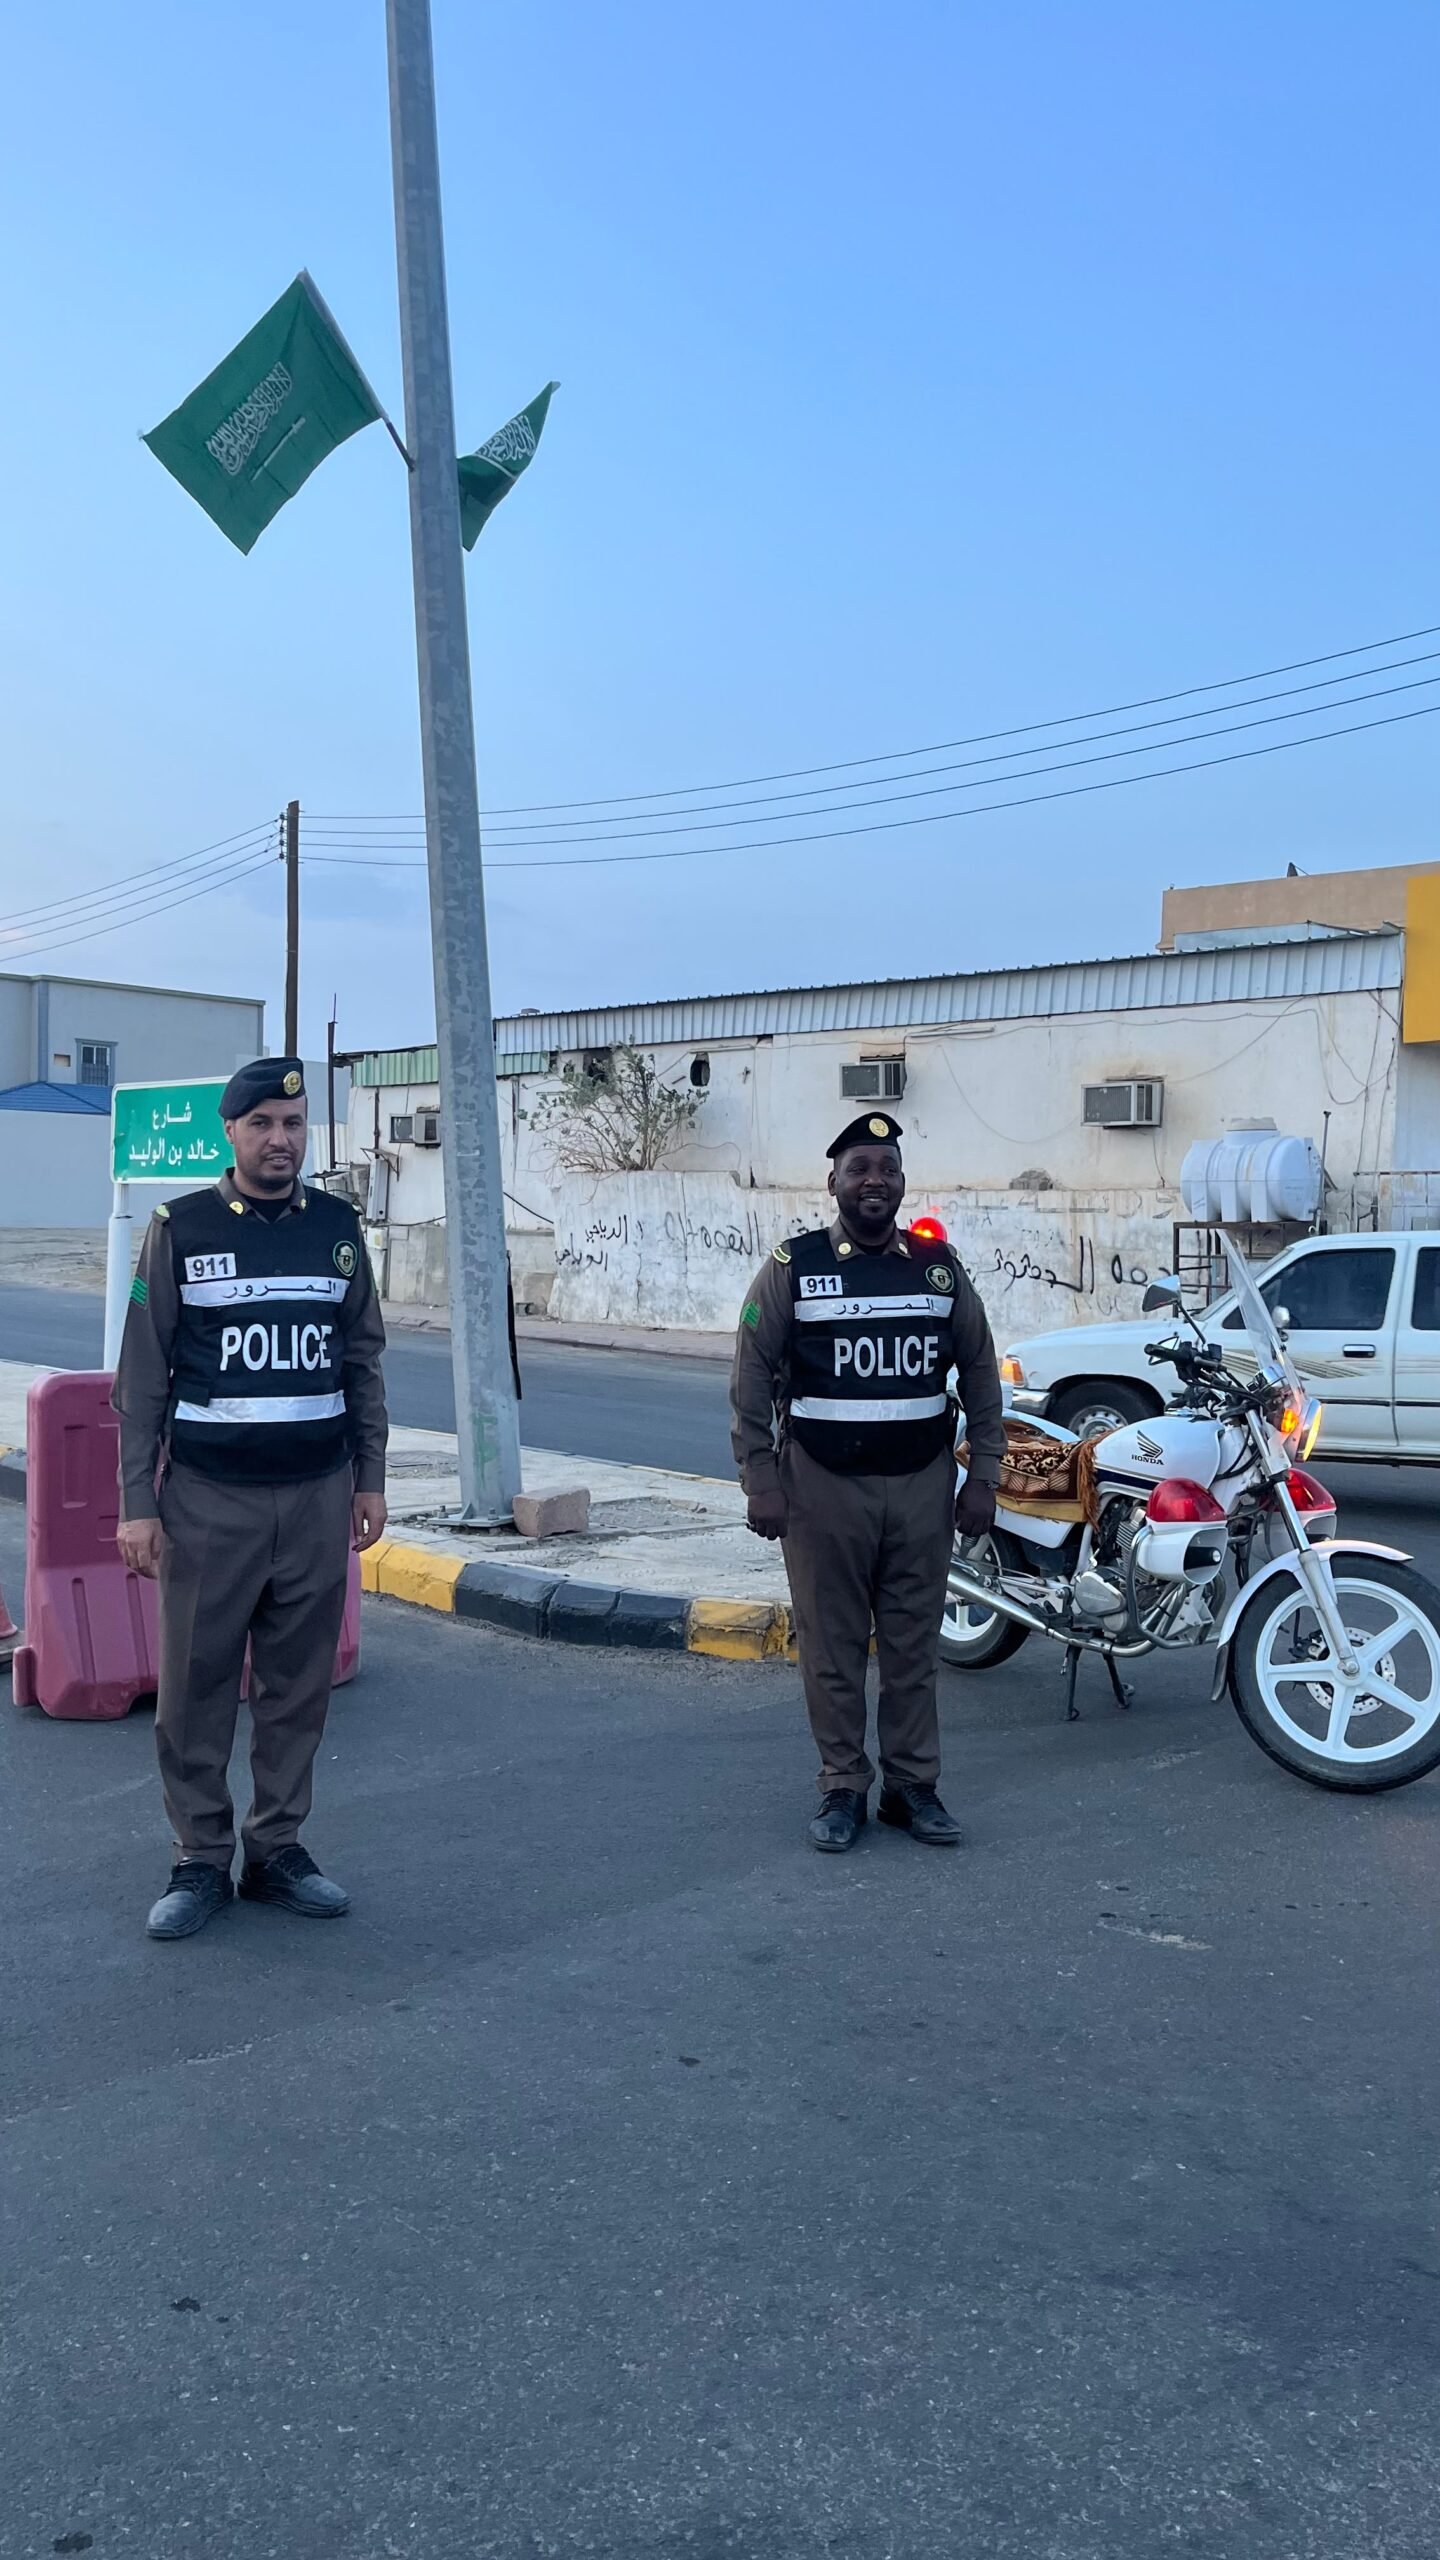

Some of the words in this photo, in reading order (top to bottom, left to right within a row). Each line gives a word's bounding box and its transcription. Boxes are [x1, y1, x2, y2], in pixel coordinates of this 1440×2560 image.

[152, 1101, 193, 1131] شارع
[128, 1136, 165, 1166] الوليد
[167, 1144, 183, 1166] بن
[187, 1138, 221, 1161] خالد
[192, 1256, 229, 1278] 911
[222, 1280, 336, 1298] المرور
[806, 1277, 838, 1294] 911
[834, 1297, 934, 1315] المرور
[219, 1323, 333, 1371] POLICE
[833, 1335, 939, 1378] POLICE
[1130, 1453, 1164, 1466] HONDA
